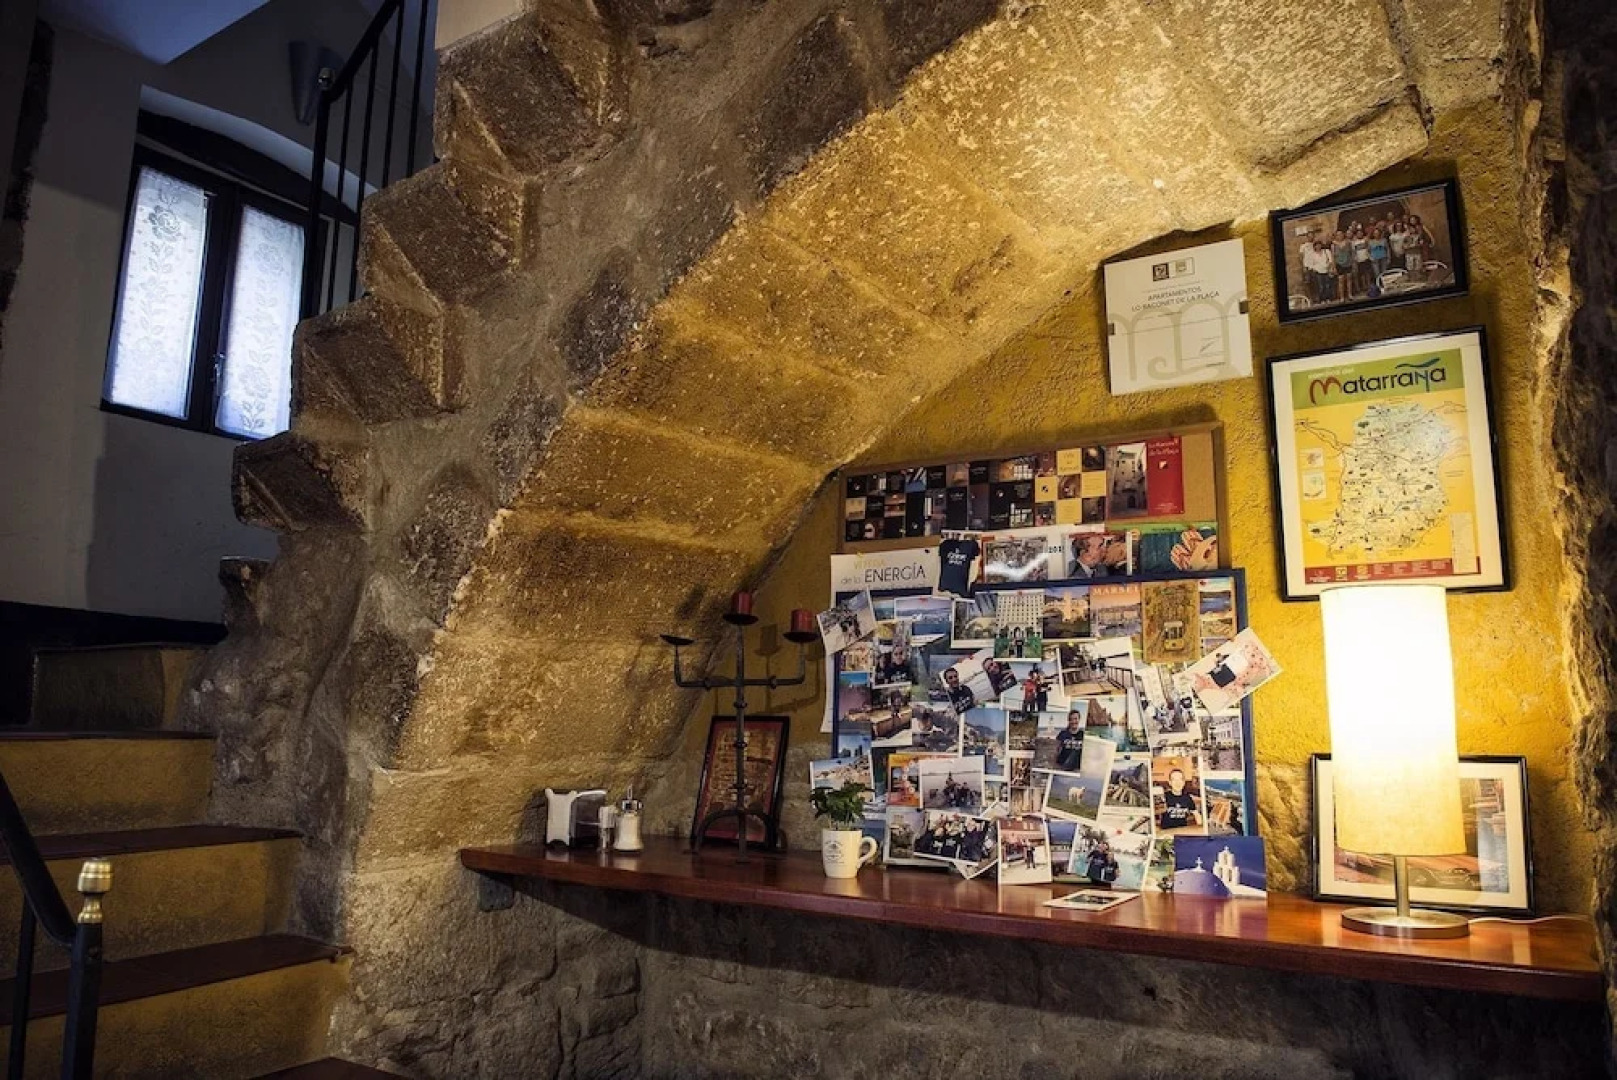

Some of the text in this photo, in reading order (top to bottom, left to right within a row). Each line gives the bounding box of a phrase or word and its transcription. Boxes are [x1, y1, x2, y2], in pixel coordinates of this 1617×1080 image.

[1148, 286, 1202, 301] APARTAMENTOS
[1197, 290, 1220, 302] PLAÇA
[1309, 357, 1446, 405] Matarraña
[841, 563, 926, 585] de la ENERGÍA
